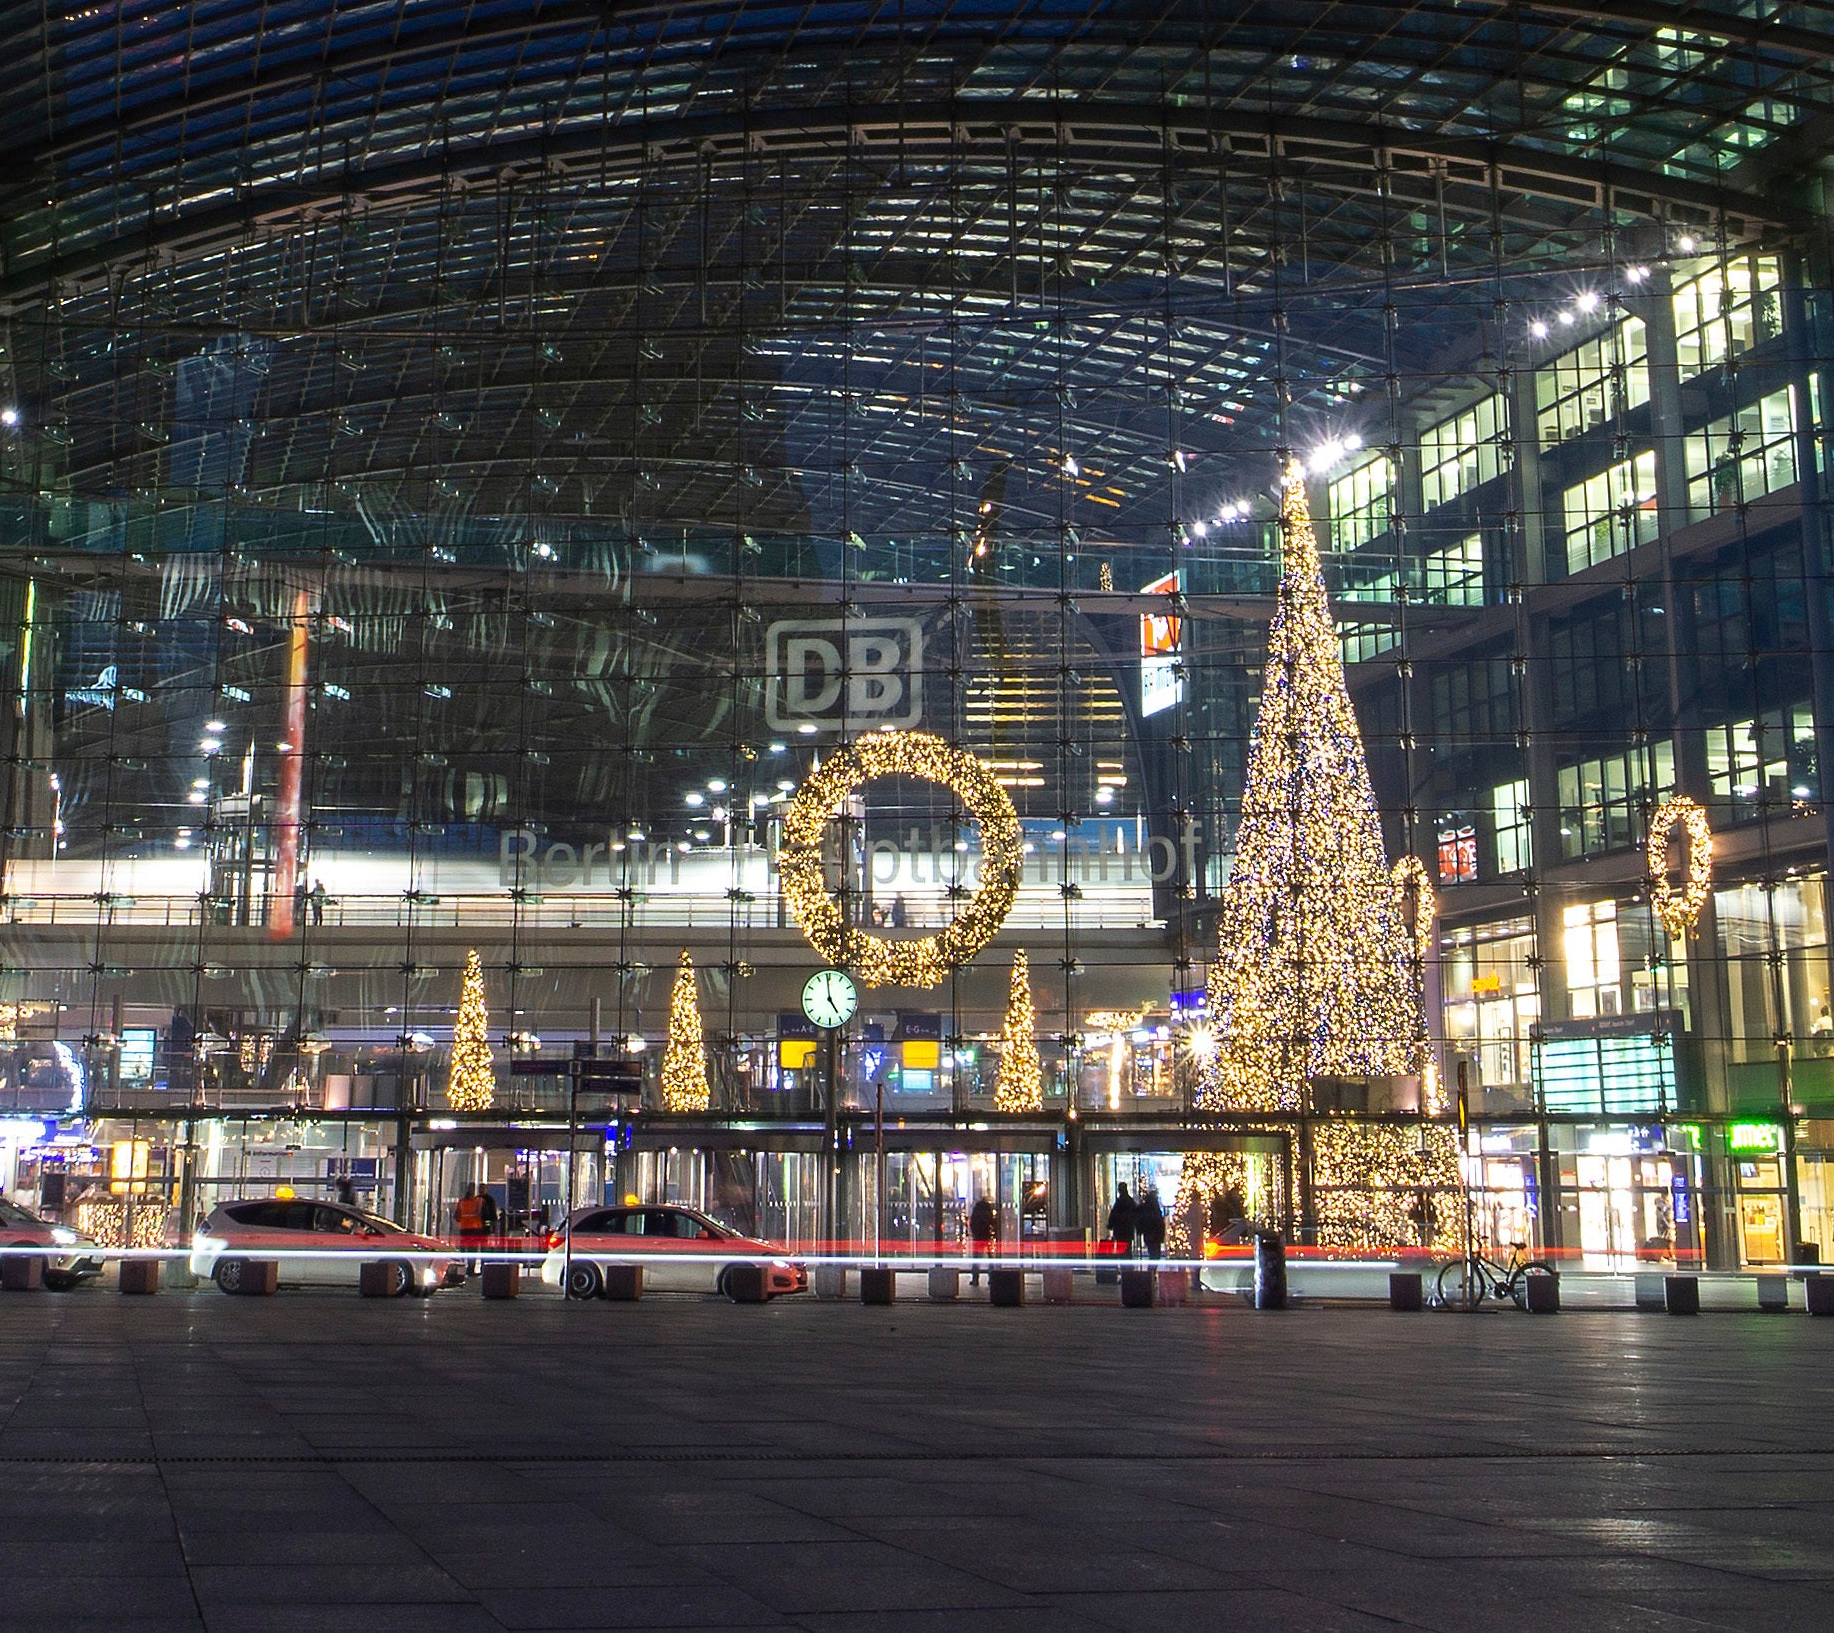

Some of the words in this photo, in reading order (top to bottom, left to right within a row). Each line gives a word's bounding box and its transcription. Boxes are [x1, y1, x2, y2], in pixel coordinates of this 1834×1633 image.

[786, 636, 903, 712] DB
[499, 828, 681, 887] Berlin
[735, 820, 1203, 900] Huptbahnhof
